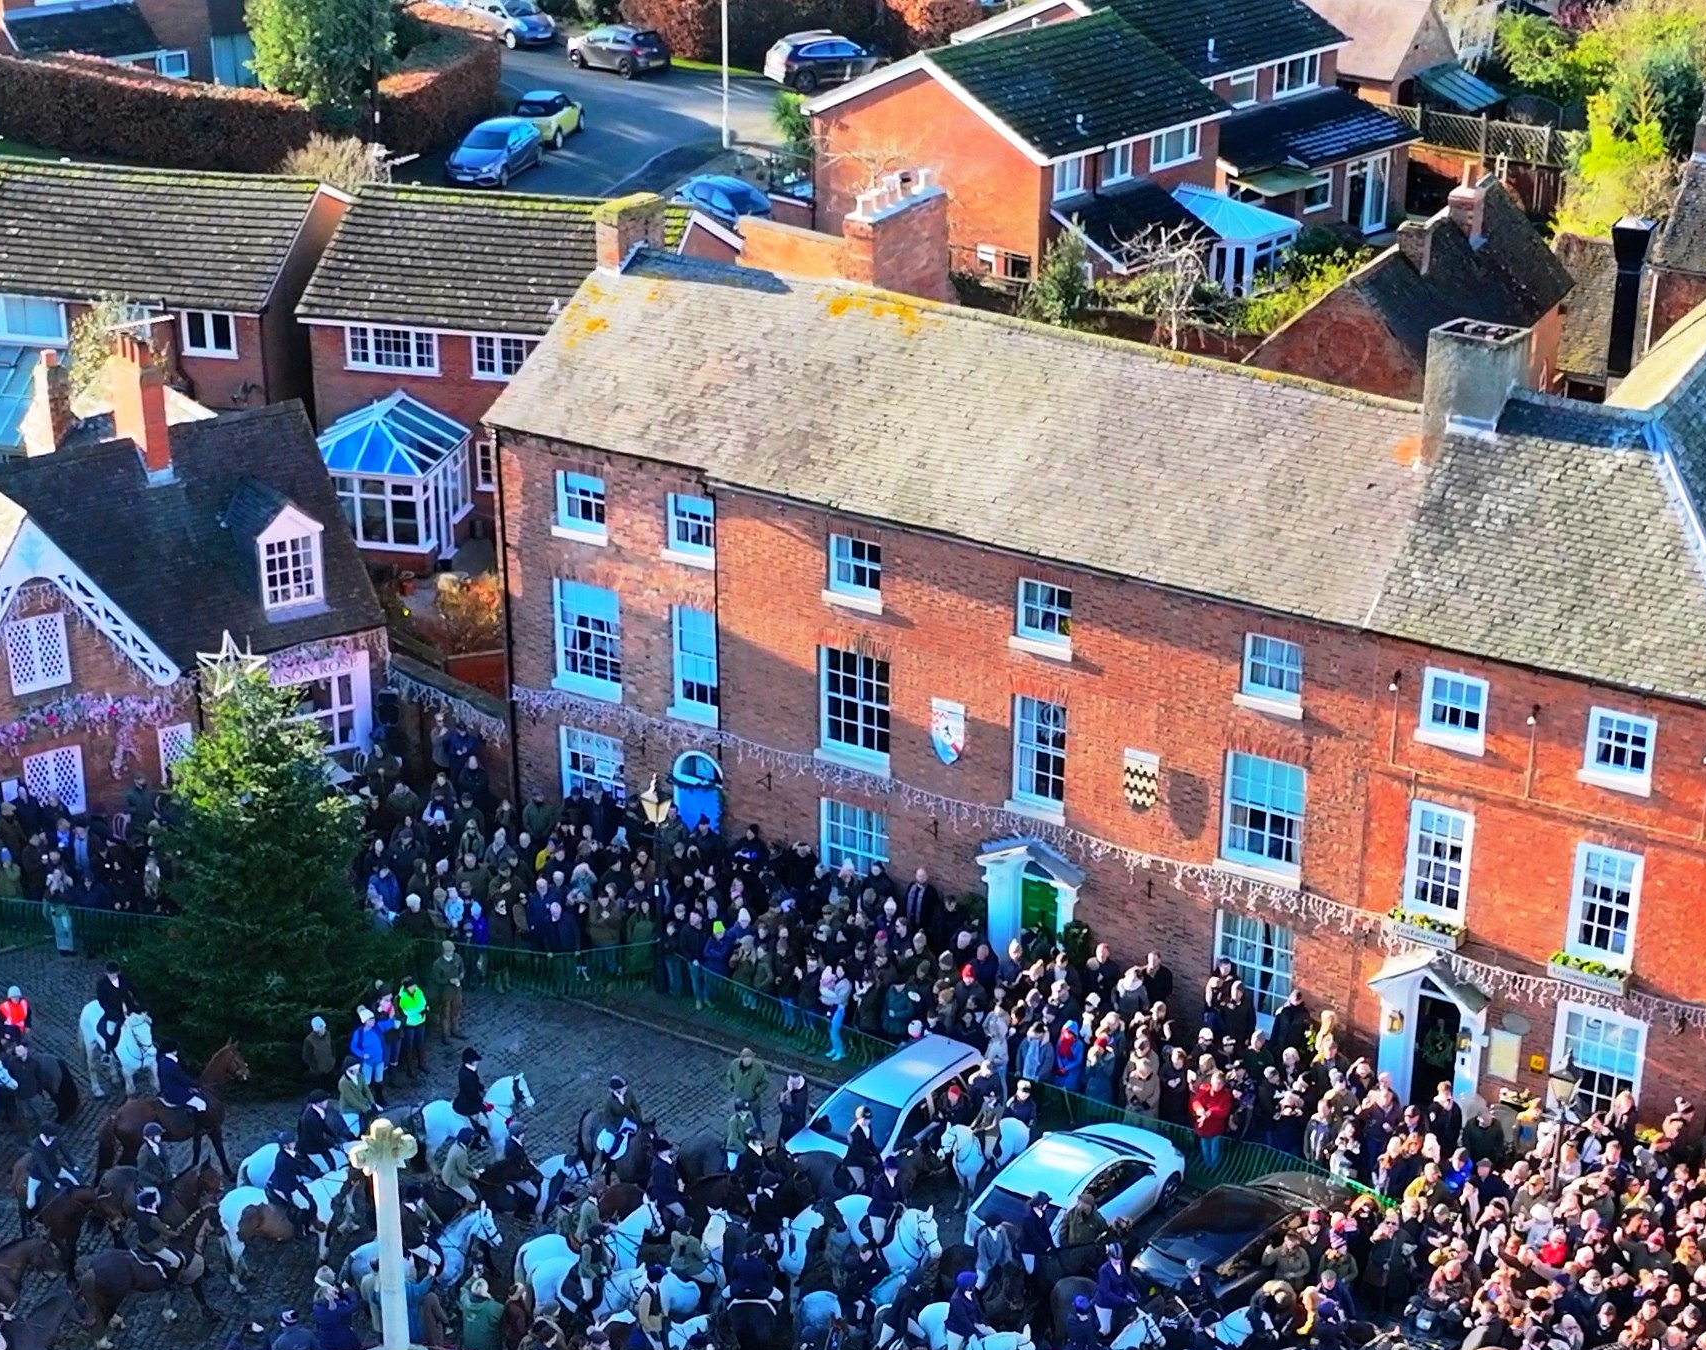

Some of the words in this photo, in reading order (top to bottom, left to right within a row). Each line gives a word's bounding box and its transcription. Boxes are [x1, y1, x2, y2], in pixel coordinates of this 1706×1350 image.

[268, 666, 314, 685] AISON
[320, 655, 360, 675] ROSE
[1392, 923, 1449, 945] Restaurant
